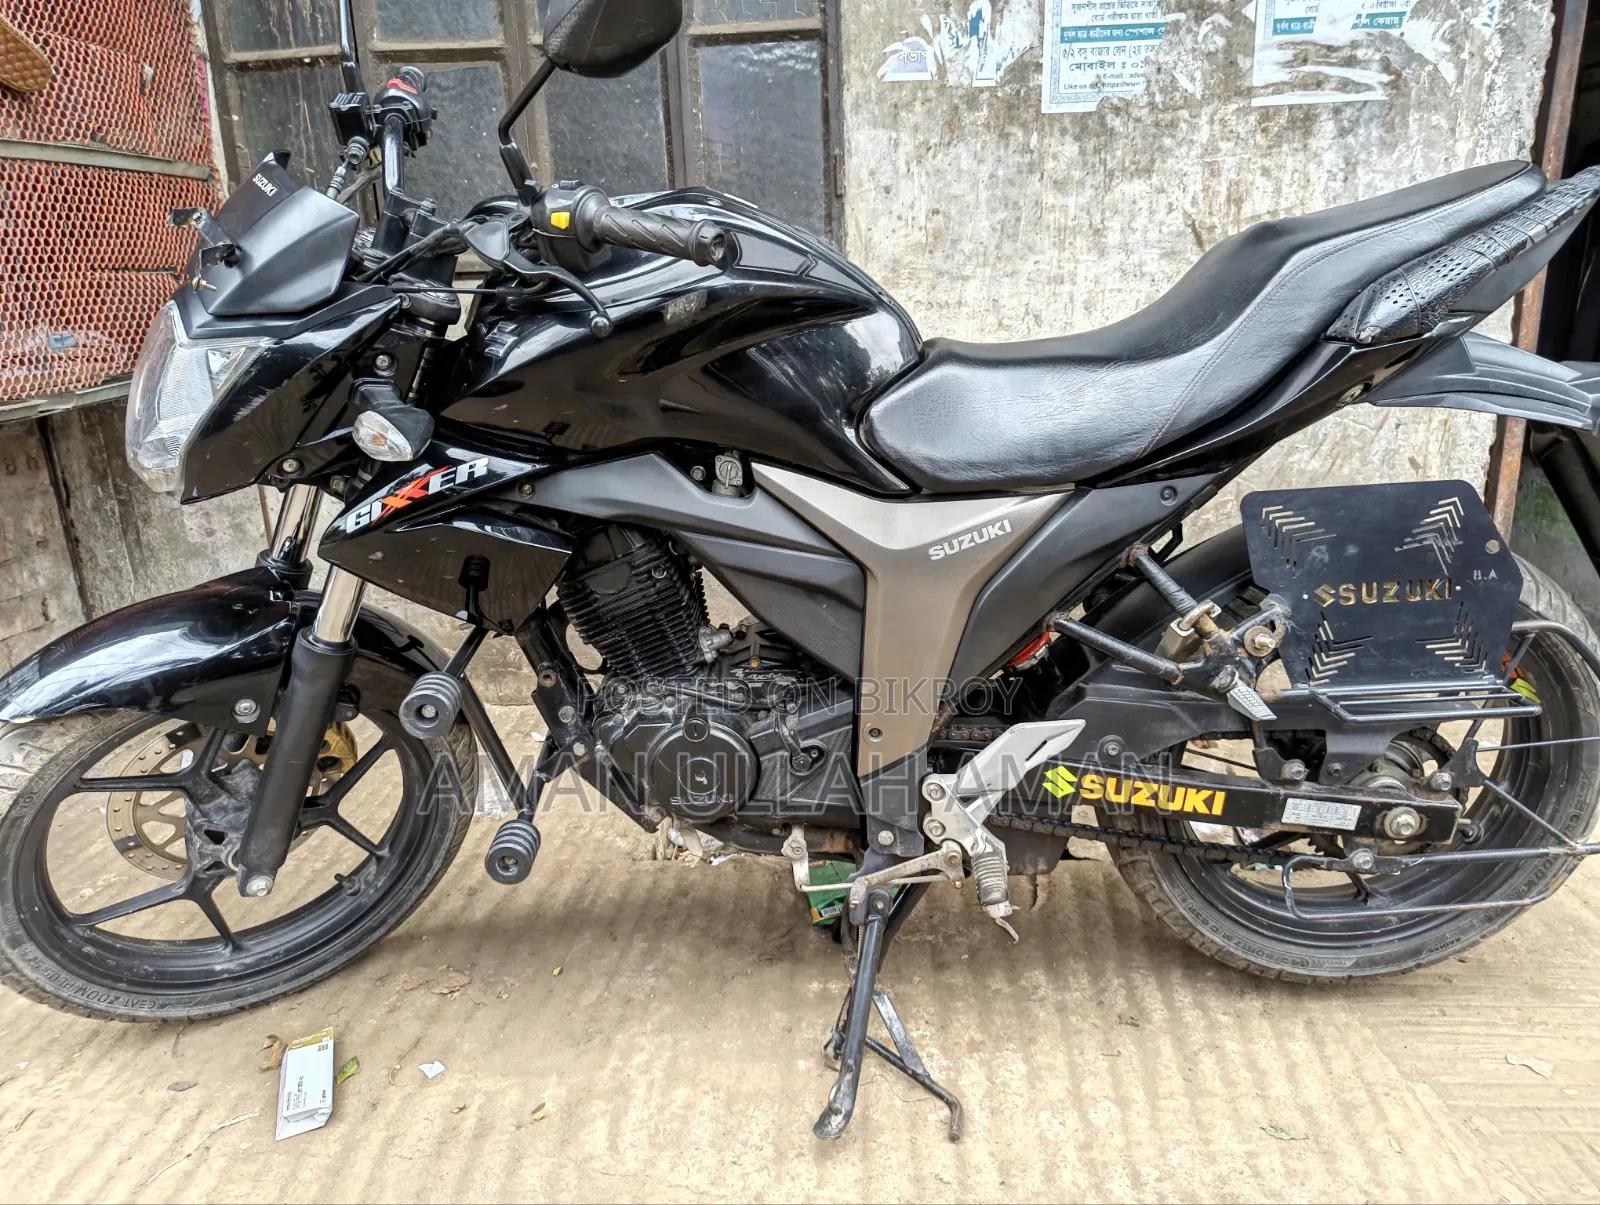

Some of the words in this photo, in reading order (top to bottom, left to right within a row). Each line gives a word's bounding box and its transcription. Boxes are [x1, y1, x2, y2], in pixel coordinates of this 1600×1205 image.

[1069, 60, 1116, 72] মোবাইল
[252, 173, 278, 197] SUZUKI
[928, 519, 1012, 560] SUZUKI
[1338, 577, 1453, 606] SUZUKI
[1079, 773, 1227, 817] SUZUKI
